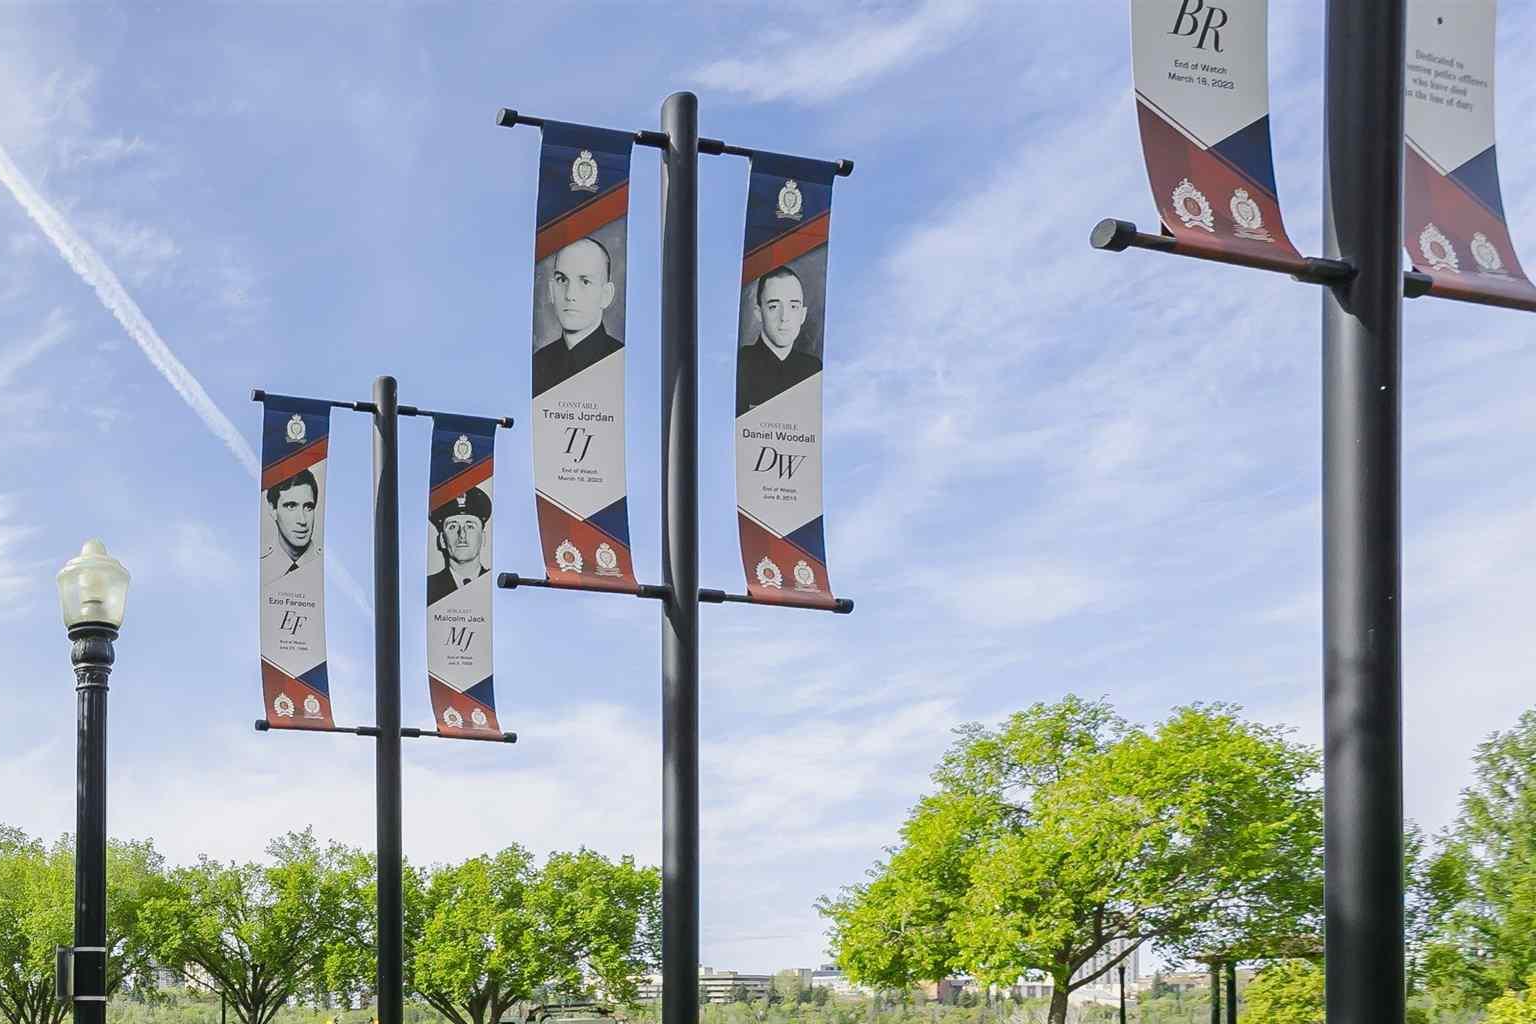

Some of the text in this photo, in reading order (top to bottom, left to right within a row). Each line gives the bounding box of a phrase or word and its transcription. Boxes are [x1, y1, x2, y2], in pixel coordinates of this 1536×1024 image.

[1167, 0, 1228, 53] BR
[1174, 60, 1227, 74] End of Watch
[1167, 72, 1194, 84] March
[1211, 79, 1234, 90] 2023
[542, 409, 614, 422] Travis Jordan
[563, 426, 596, 463] TJ
[743, 428, 816, 443] Daniel Woodall
[752, 446, 807, 480] DW
[280, 610, 308, 635] EF
[467, 615, 486, 623] Jack
[444, 626, 476, 653] MJ
